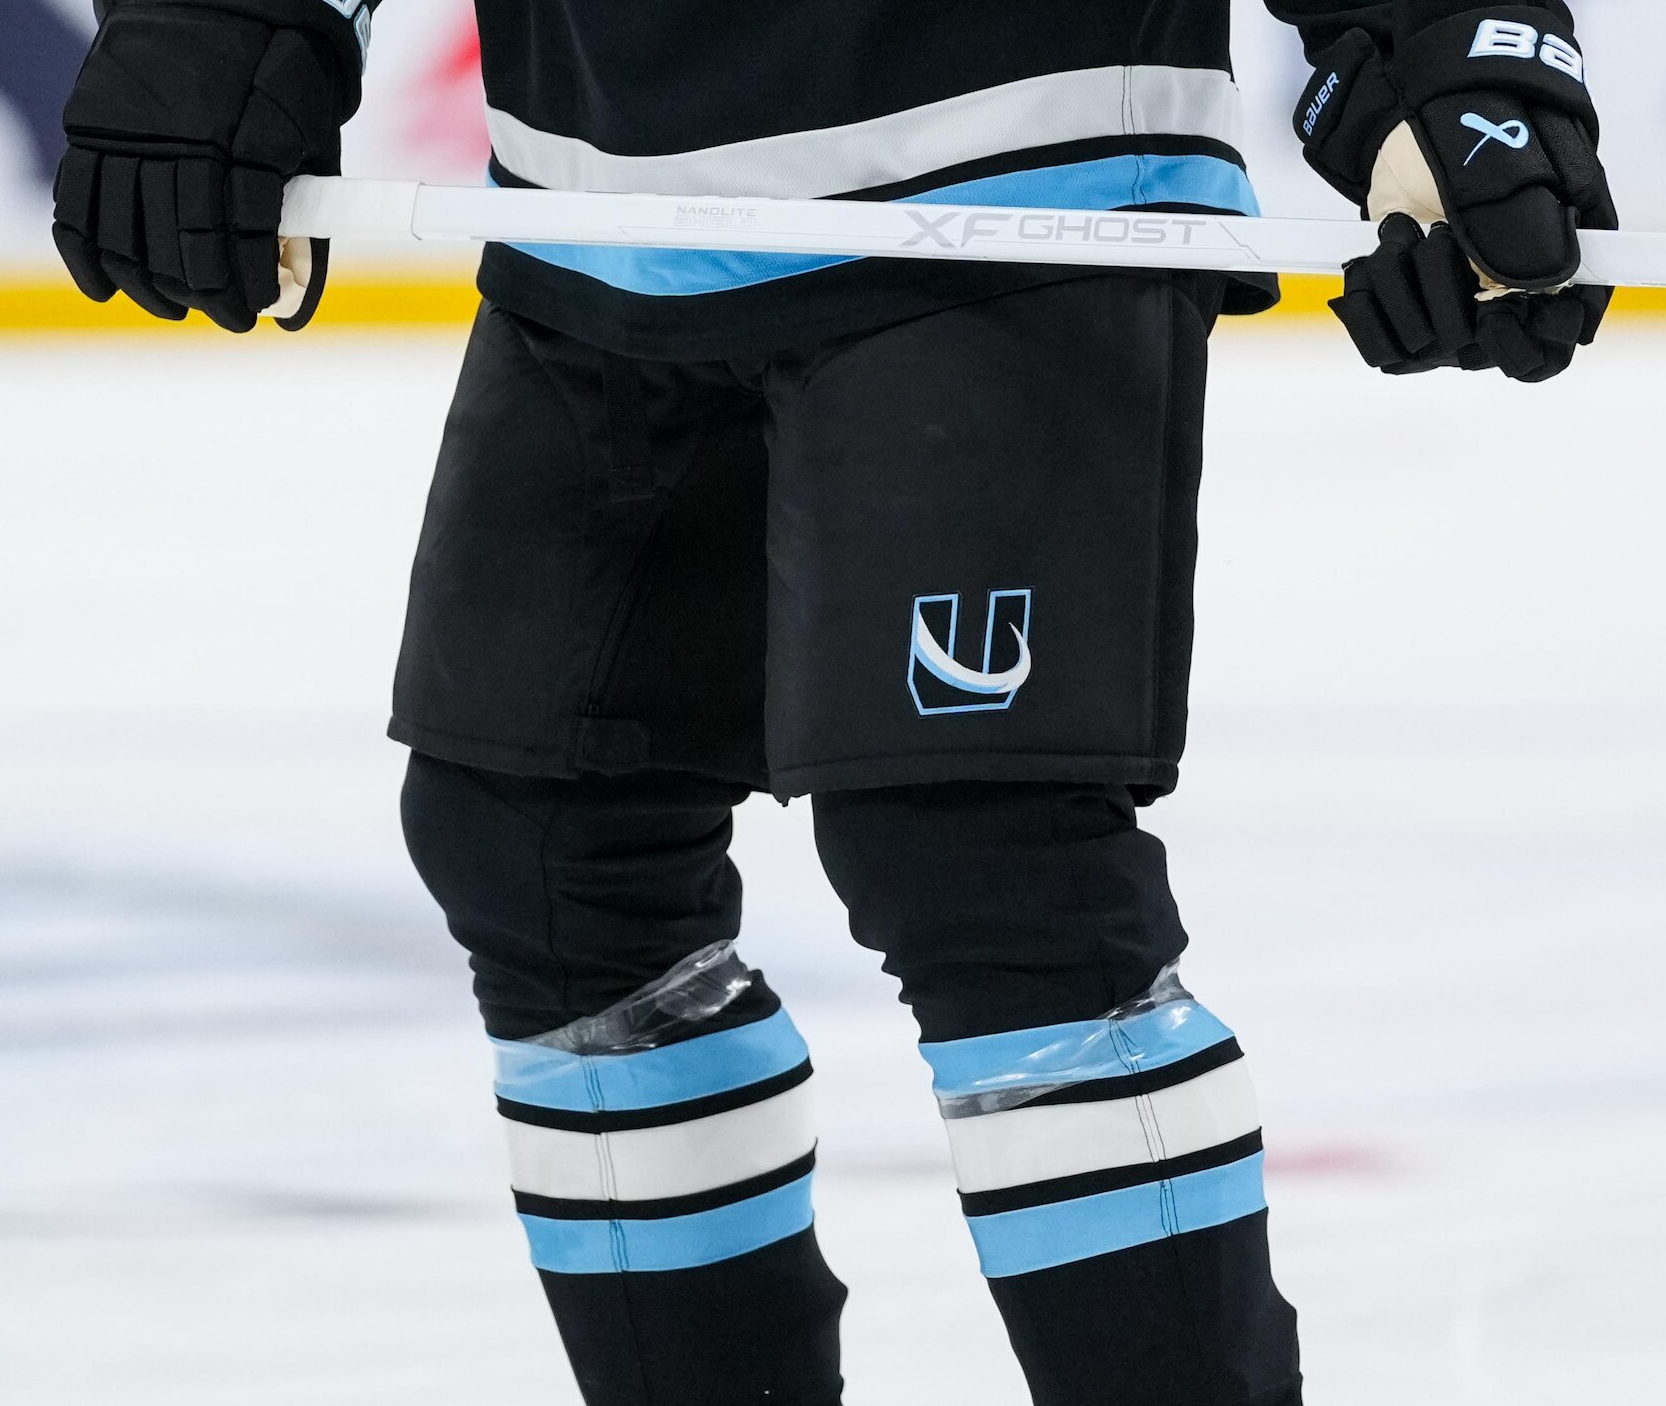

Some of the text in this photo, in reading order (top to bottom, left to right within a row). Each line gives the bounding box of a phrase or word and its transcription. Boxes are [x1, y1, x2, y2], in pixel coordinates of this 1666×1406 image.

[676, 205, 758, 217] NANOLITE
[898, 210, 1207, 249] XF GHOST
